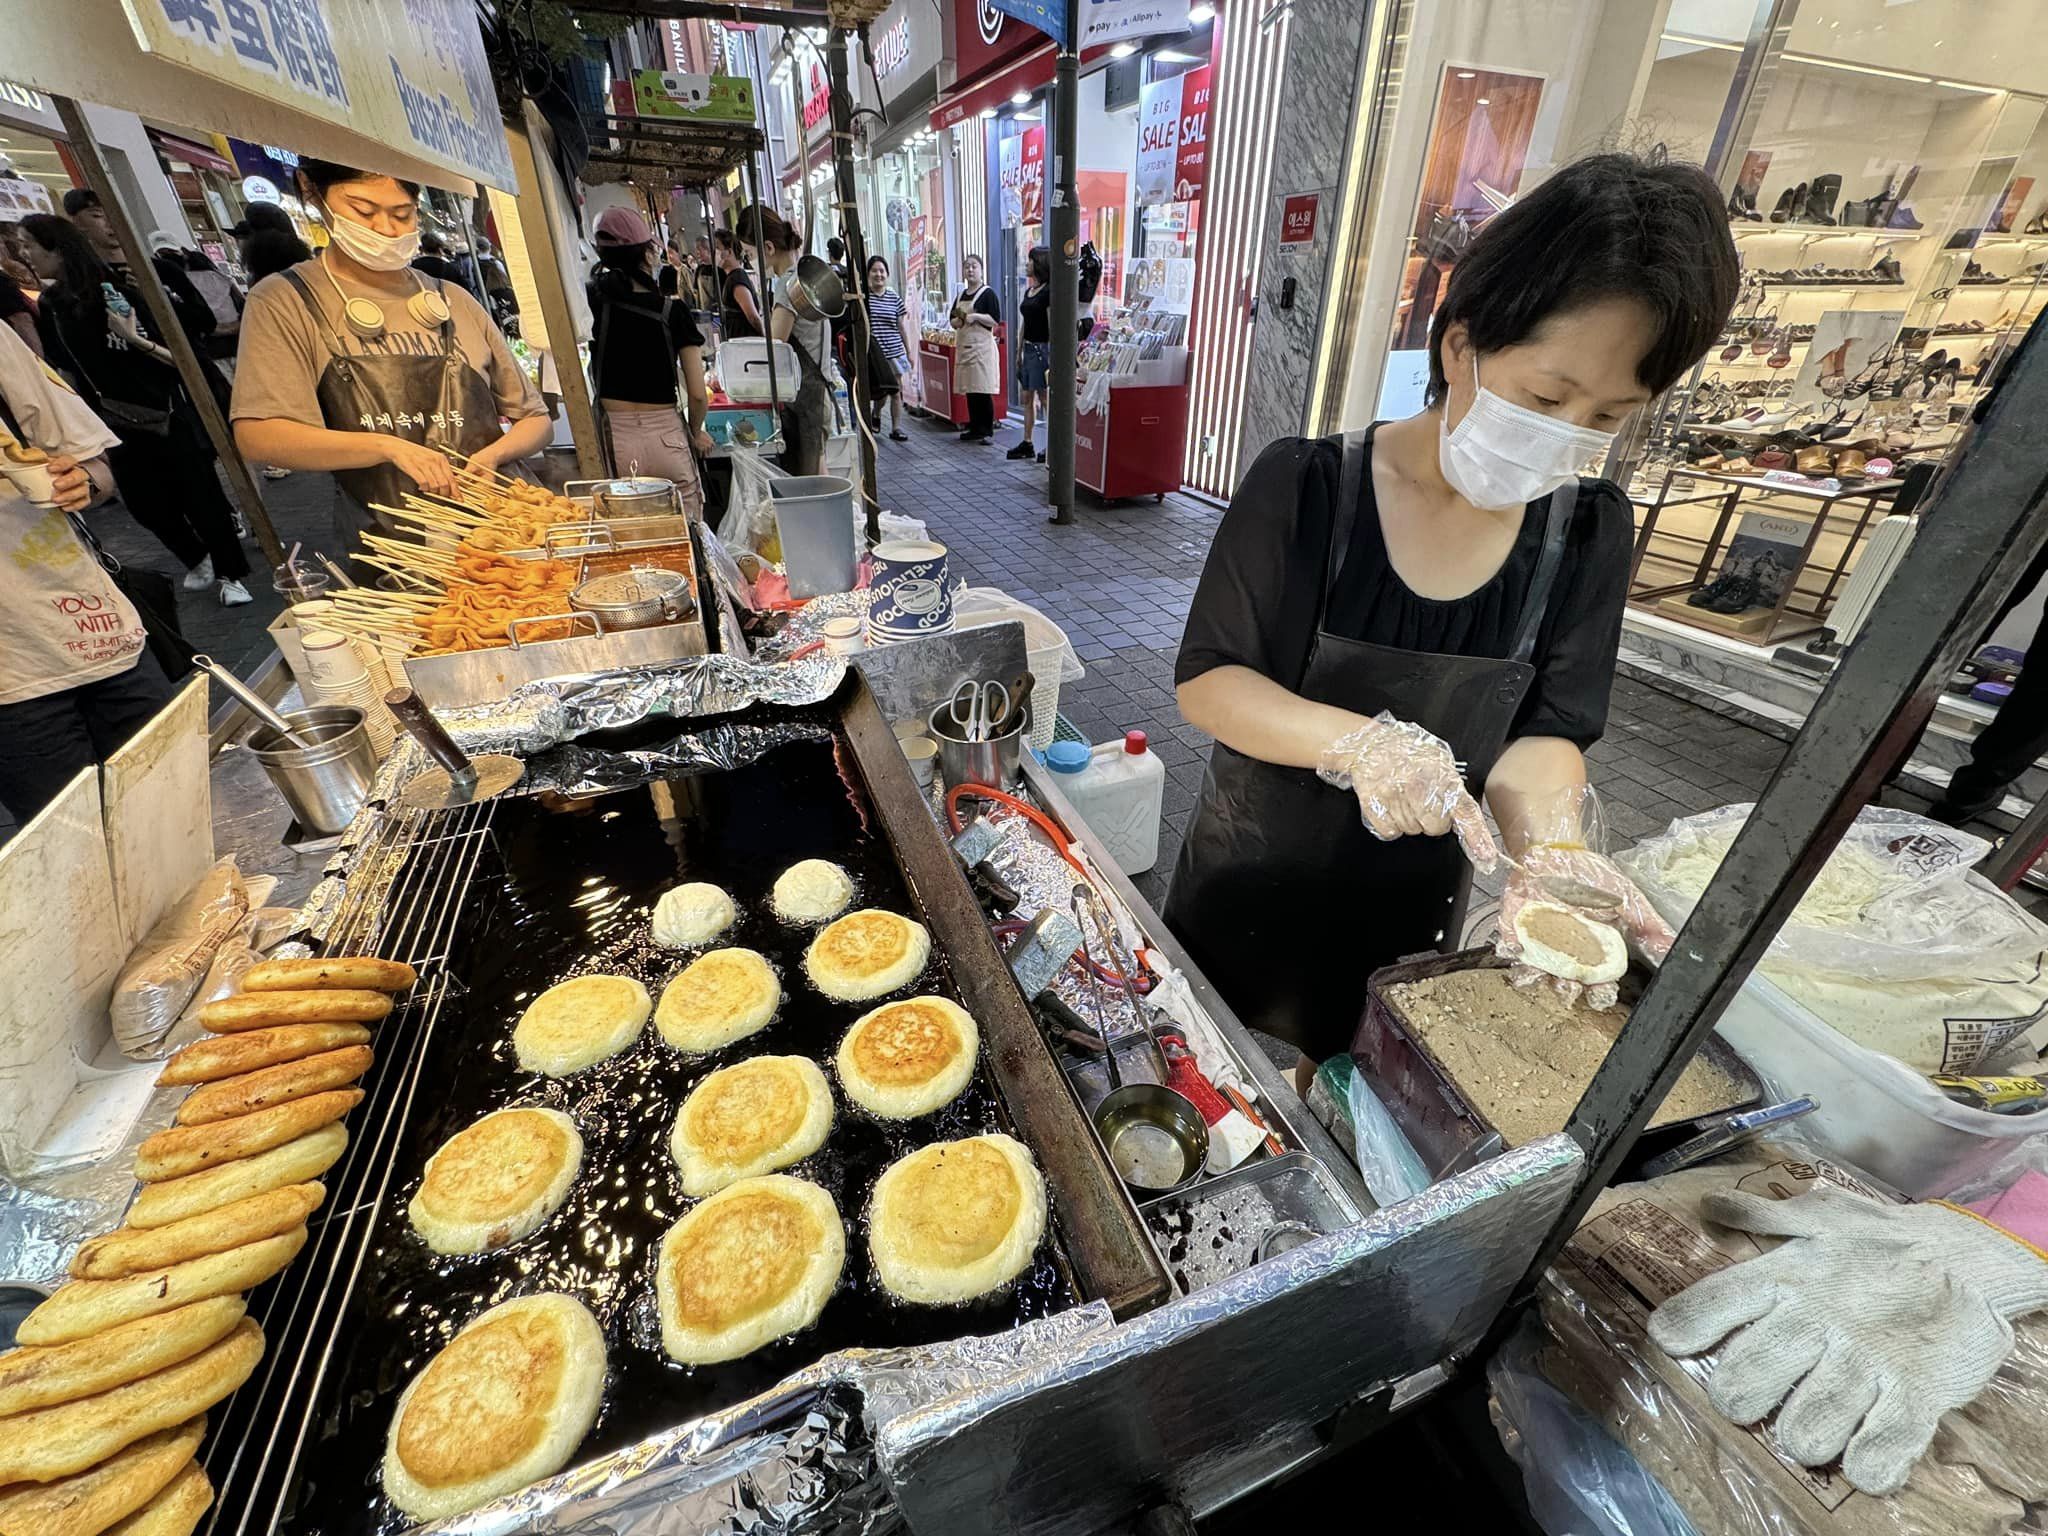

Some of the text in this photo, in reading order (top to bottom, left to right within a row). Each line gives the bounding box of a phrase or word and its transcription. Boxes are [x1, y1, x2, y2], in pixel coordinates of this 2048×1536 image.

[873, 15, 909, 81] ETUDE
[388, 53, 452, 156] Busan
[1152, 100, 1170, 116] BIG
[1141, 120, 1176, 153] SALE
[1181, 112, 1206, 147] SAL
[1001, 166, 1021, 190] SALE
[1022, 160, 1043, 186] SALE
[1288, 210, 1312, 228] 에스원
[430, 410, 465, 429] 명동
[876, 605, 905, 625] OOD
[917, 594, 950, 628] FOOD
[63, 641, 88, 653] THE
